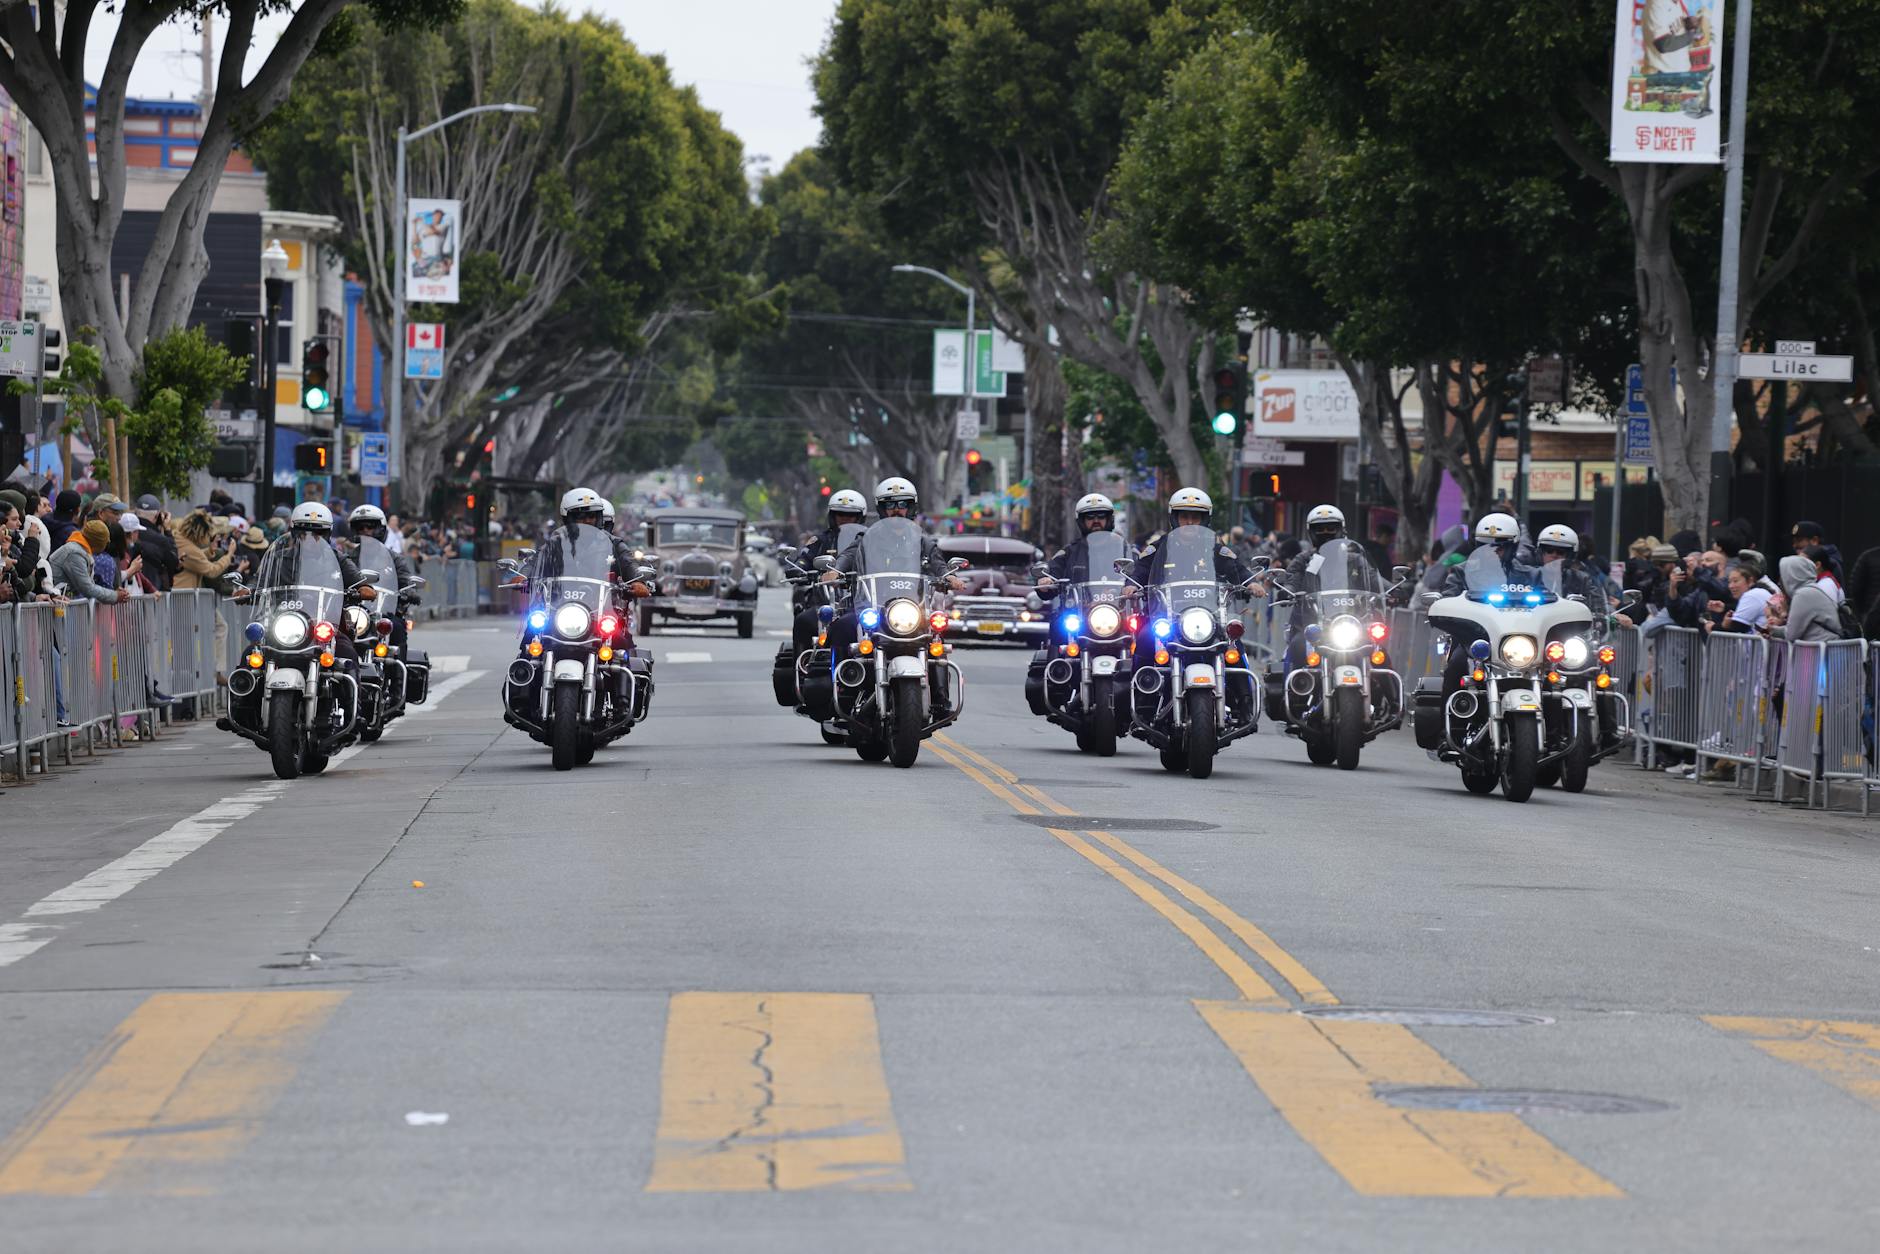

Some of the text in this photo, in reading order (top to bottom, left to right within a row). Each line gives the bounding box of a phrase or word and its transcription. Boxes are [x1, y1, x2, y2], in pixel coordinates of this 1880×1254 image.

[1654, 137, 1696, 151] LIKE IT
[1772, 360, 1818, 375] Lilac
[1262, 453, 1287, 464] Capp
[889, 580, 912, 590] 382
[563, 590, 586, 600] 387
[1093, 593, 1115, 602] 383
[1183, 589, 1206, 599] 358
[280, 600, 303, 610] 369
[1332, 597, 1355, 607] 363
